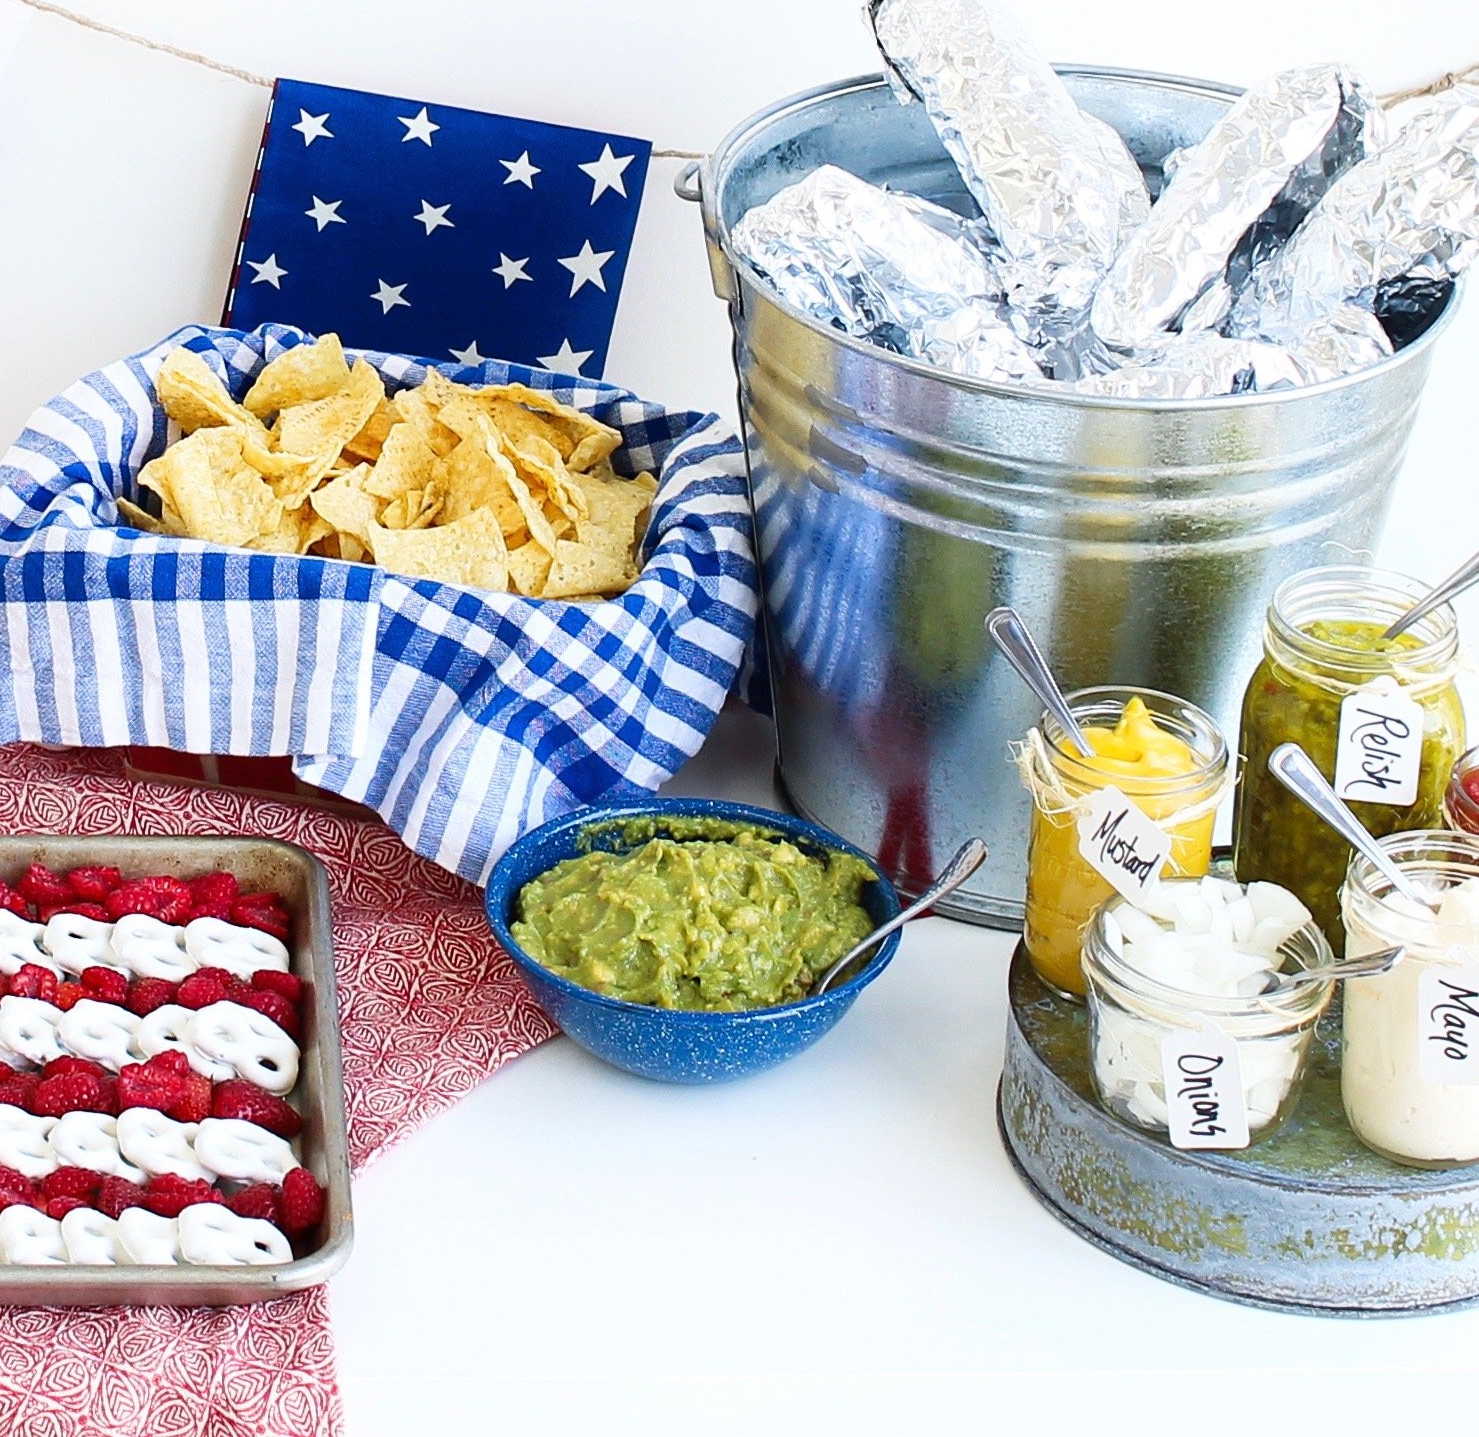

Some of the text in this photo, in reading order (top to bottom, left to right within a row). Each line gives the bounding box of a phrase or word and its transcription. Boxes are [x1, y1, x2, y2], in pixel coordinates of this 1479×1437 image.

[1344, 708, 1410, 793] Relish
[1091, 808, 1160, 888] Mustard
[1428, 978, 1479, 1060] Mayo
[1177, 1053, 1227, 1137] Onions
